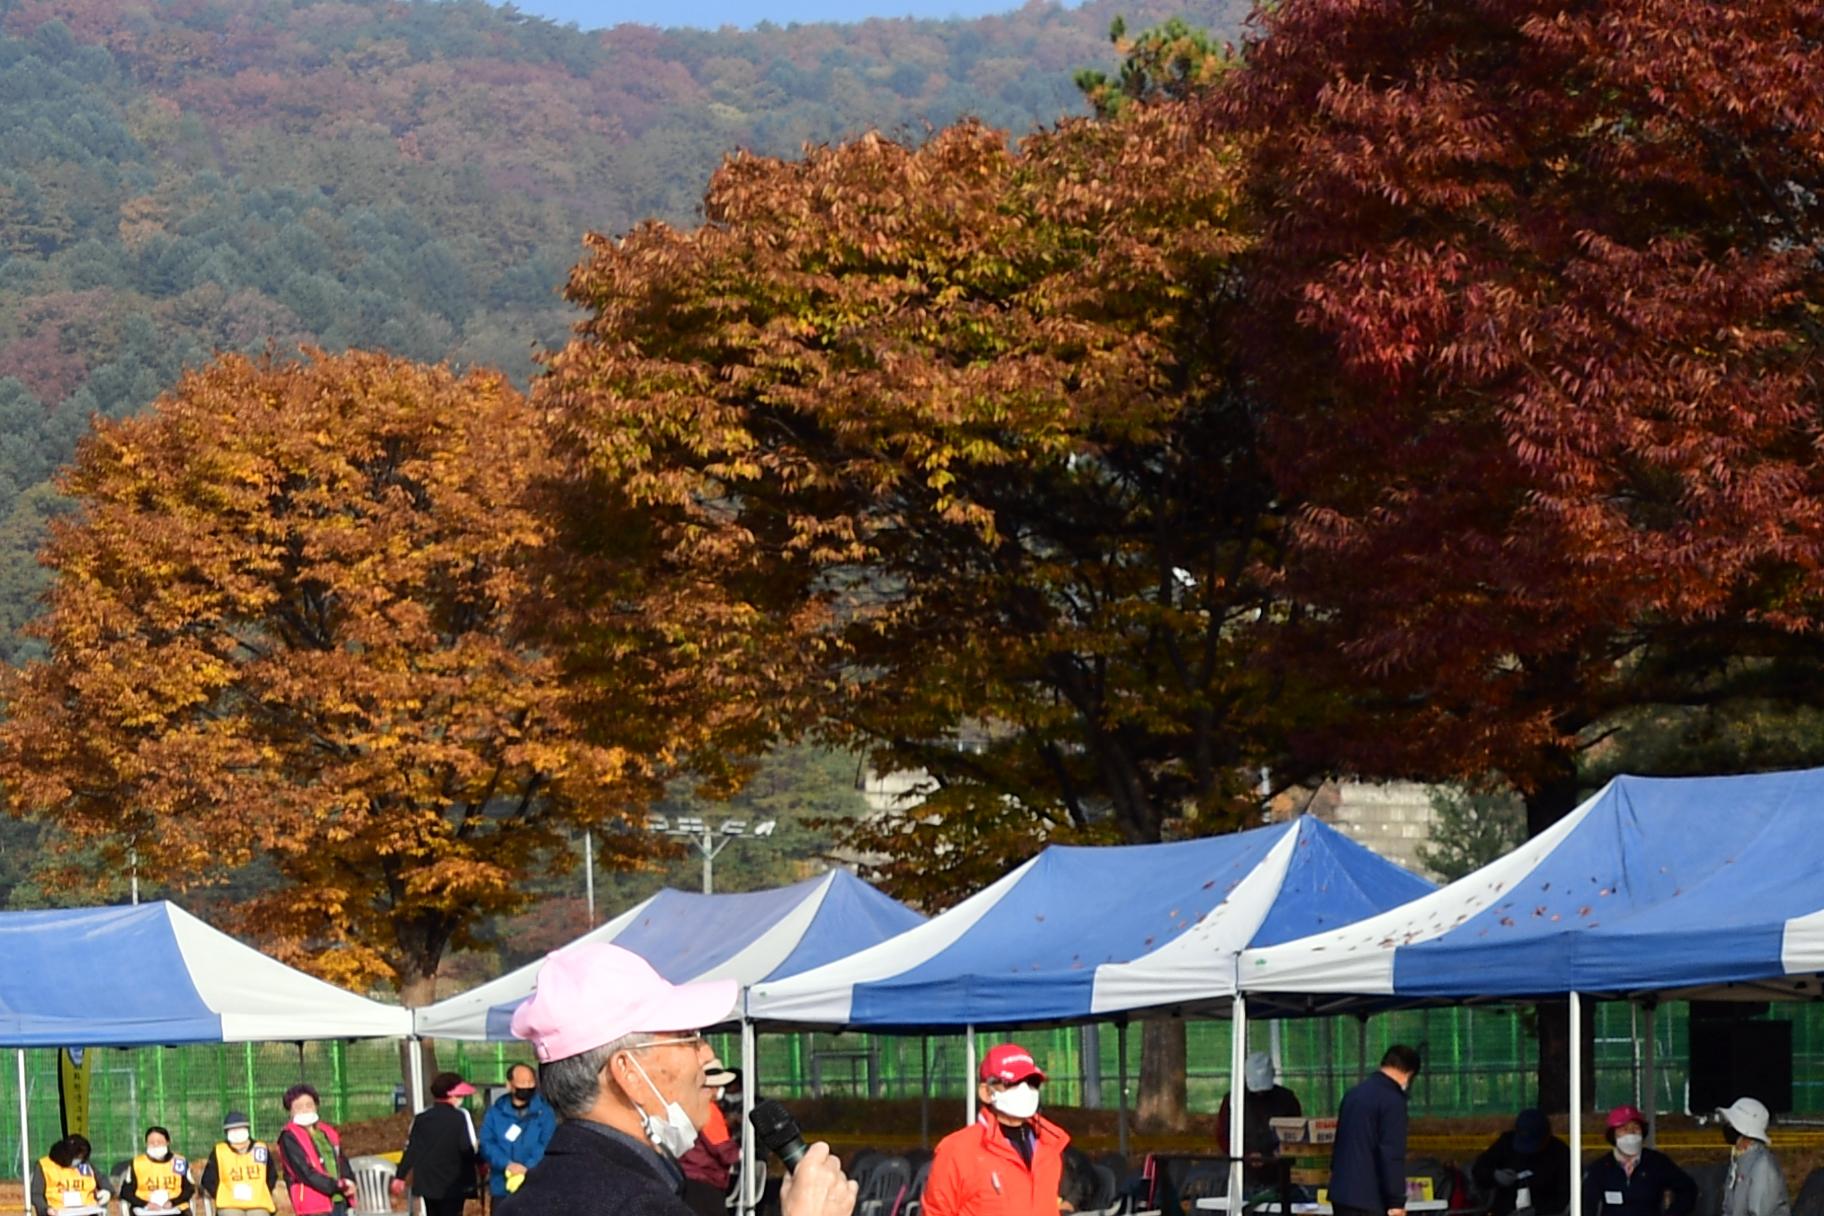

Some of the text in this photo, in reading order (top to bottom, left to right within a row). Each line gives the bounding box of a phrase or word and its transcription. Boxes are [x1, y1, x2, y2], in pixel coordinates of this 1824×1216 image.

[257, 1148, 265, 1161] 6
[229, 1165, 261, 1181] 심판
[56, 1179, 85, 1192] 심판
[145, 1175, 177, 1191] 심판
